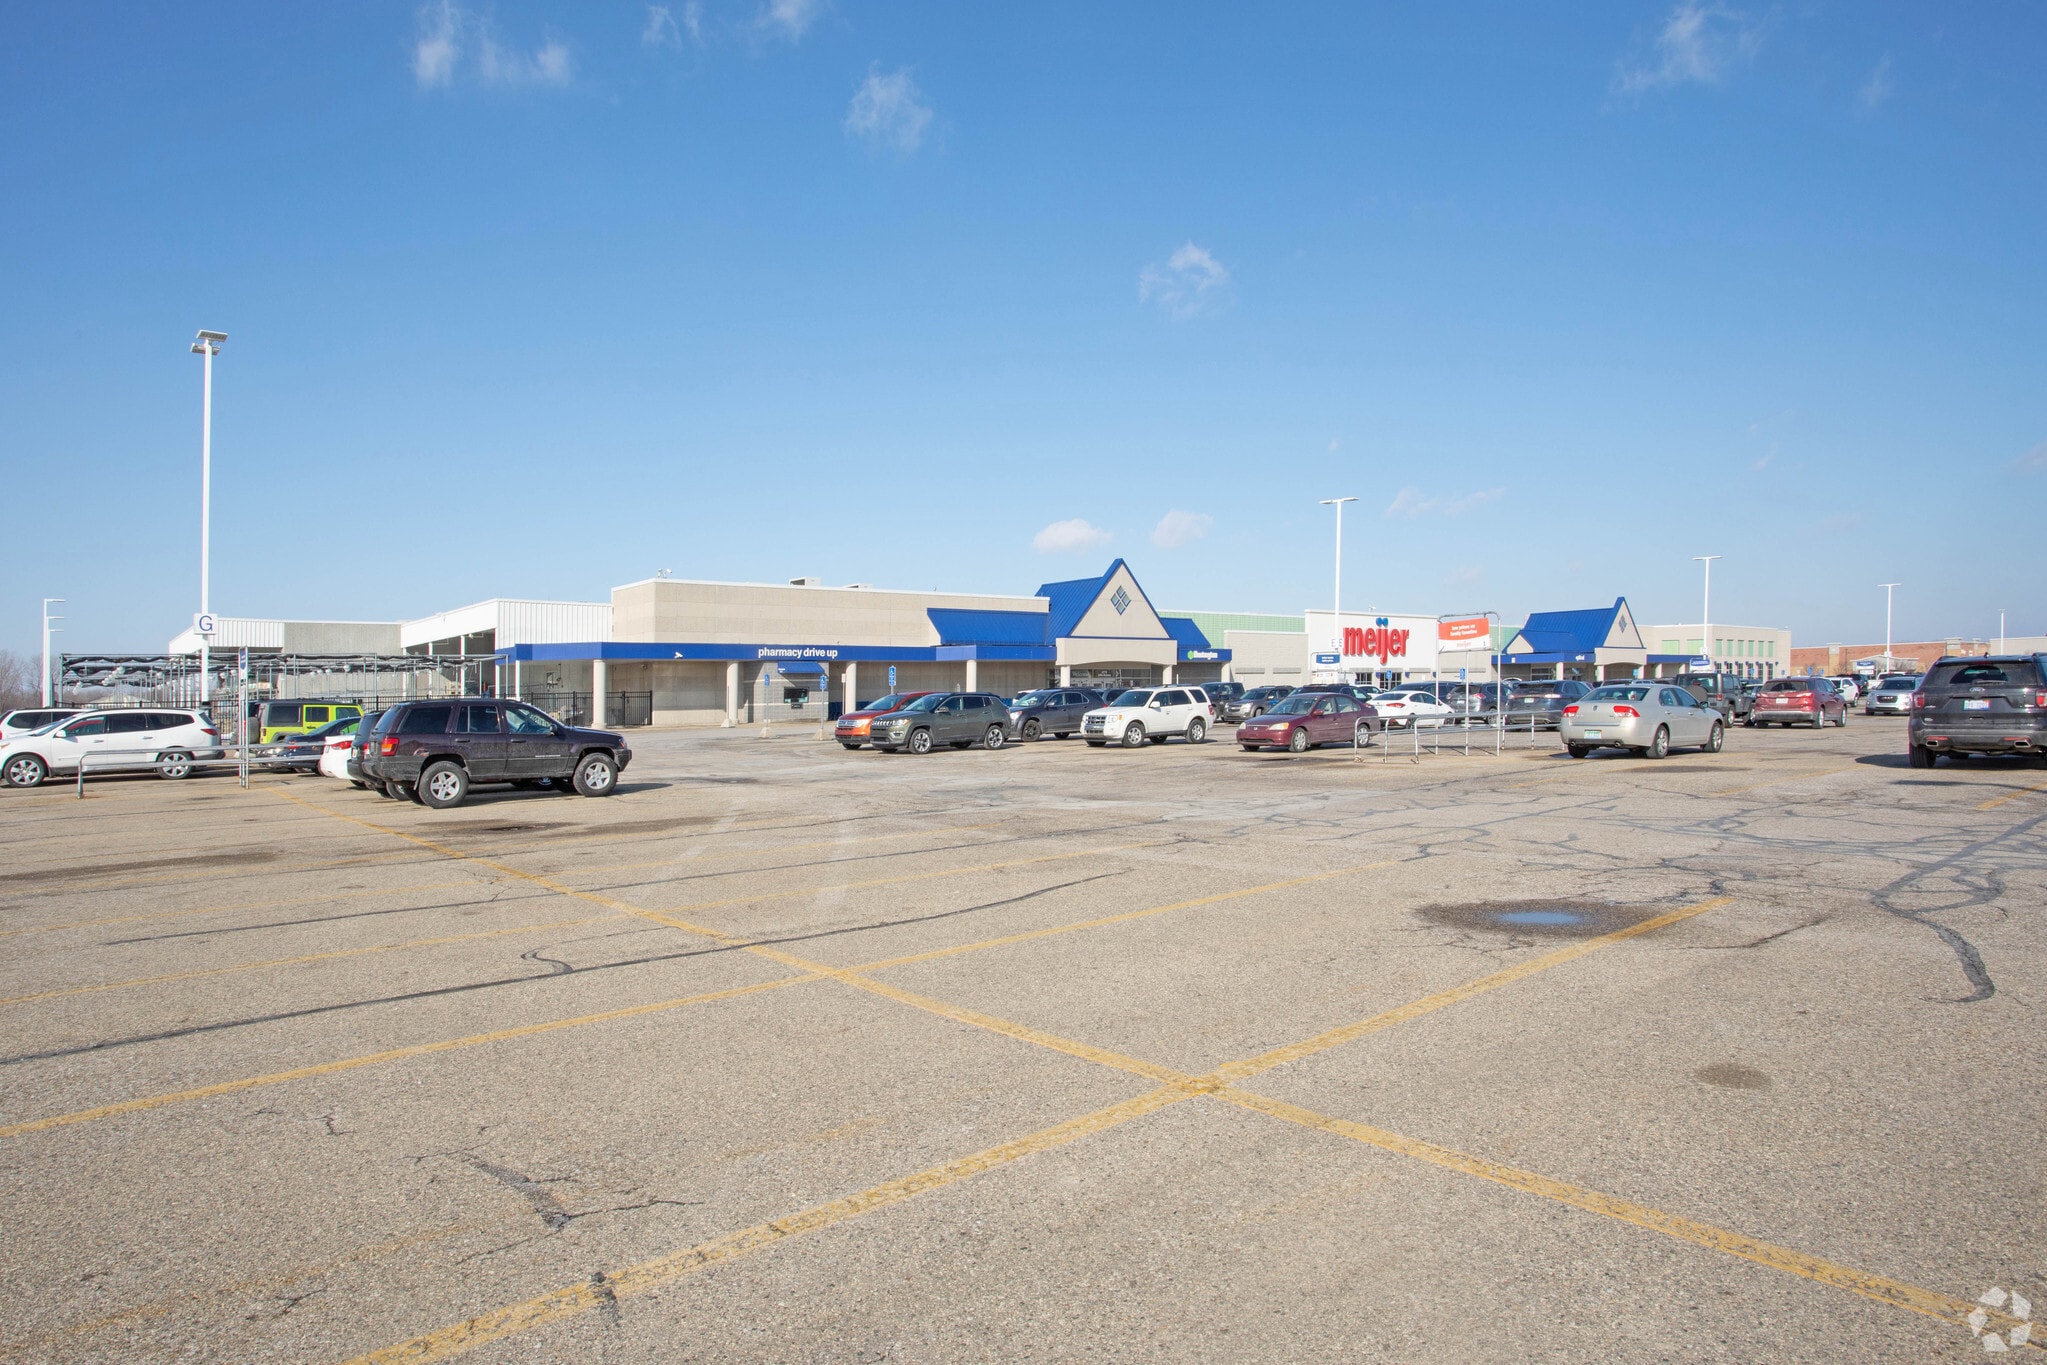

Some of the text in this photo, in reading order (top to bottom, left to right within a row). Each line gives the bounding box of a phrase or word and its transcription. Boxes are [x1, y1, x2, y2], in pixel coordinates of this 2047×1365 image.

[199, 615, 213, 631] G
[1343, 617, 1410, 666] meijer
[758, 647, 838, 659] pharmacy drive up
